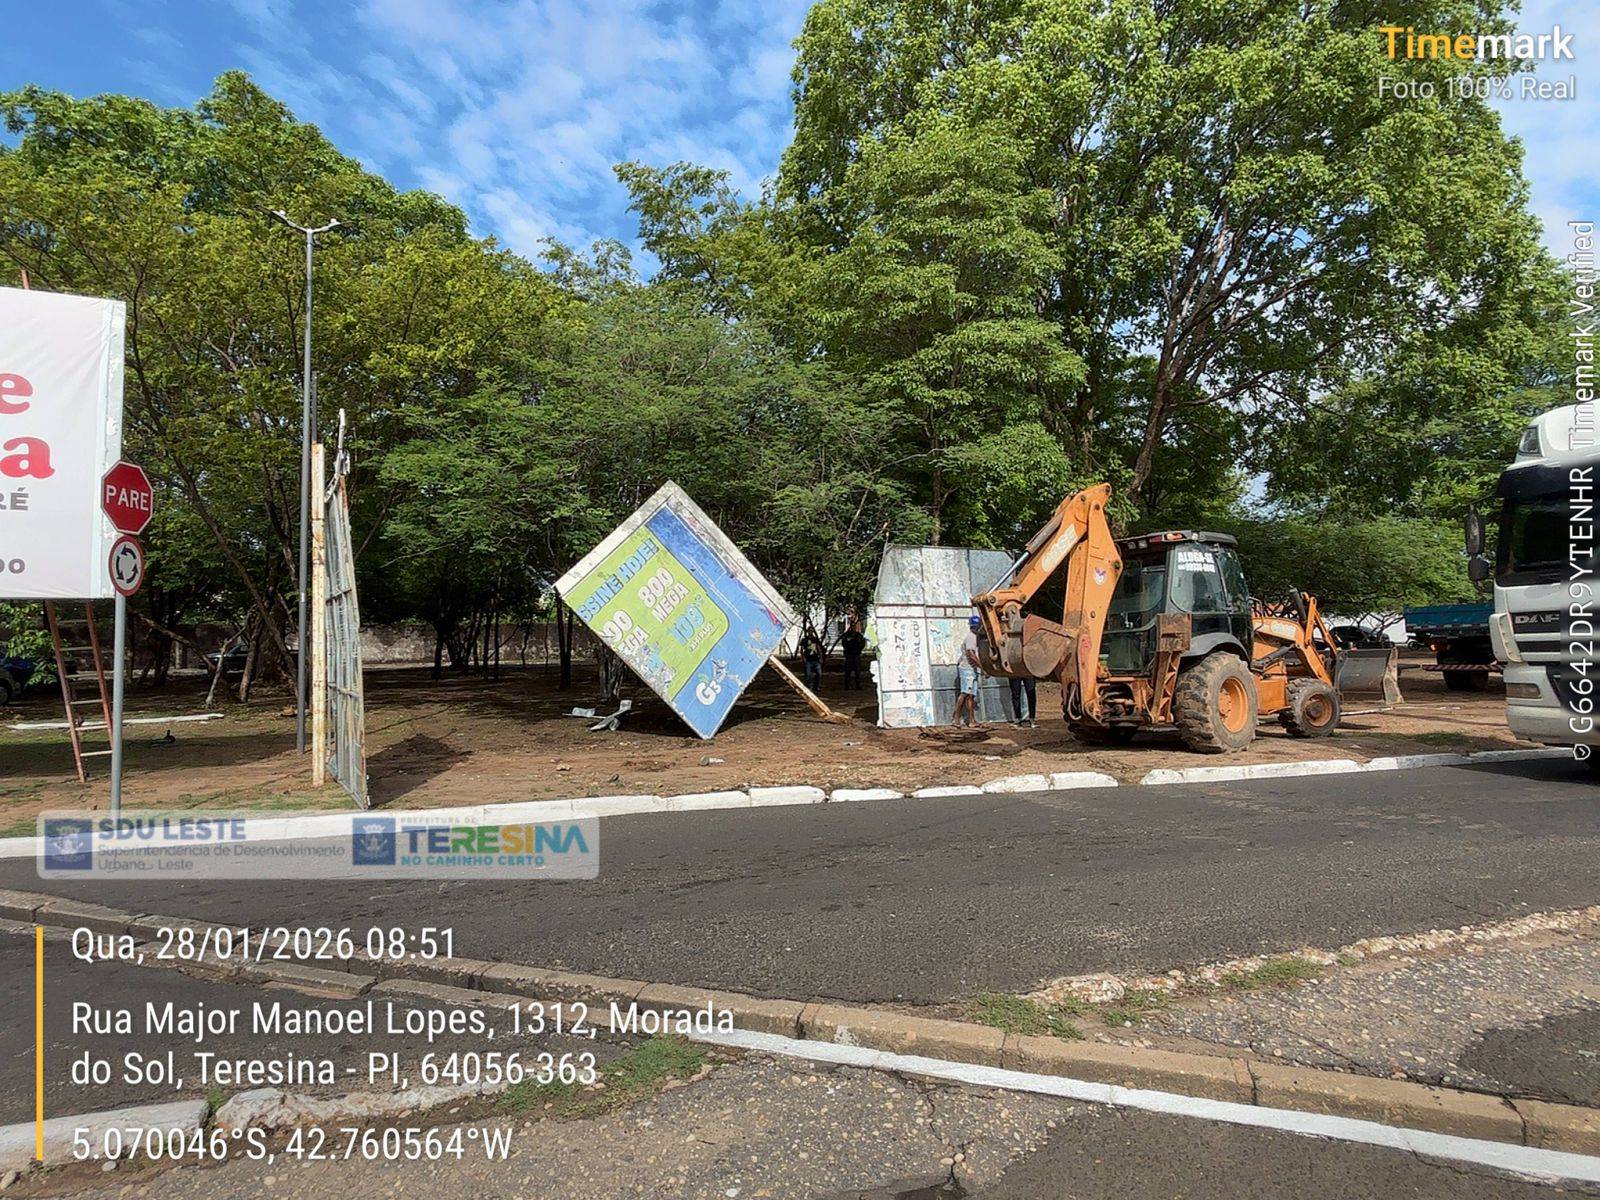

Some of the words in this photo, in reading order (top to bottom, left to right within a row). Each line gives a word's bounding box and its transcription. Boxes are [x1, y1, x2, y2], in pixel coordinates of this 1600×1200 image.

[0, 436, 55, 479] a
[106, 484, 149, 511] PARE
[638, 567, 674, 608] 800
[652, 582, 690, 623] MEGA
[1515, 614, 1559, 624] DAF
